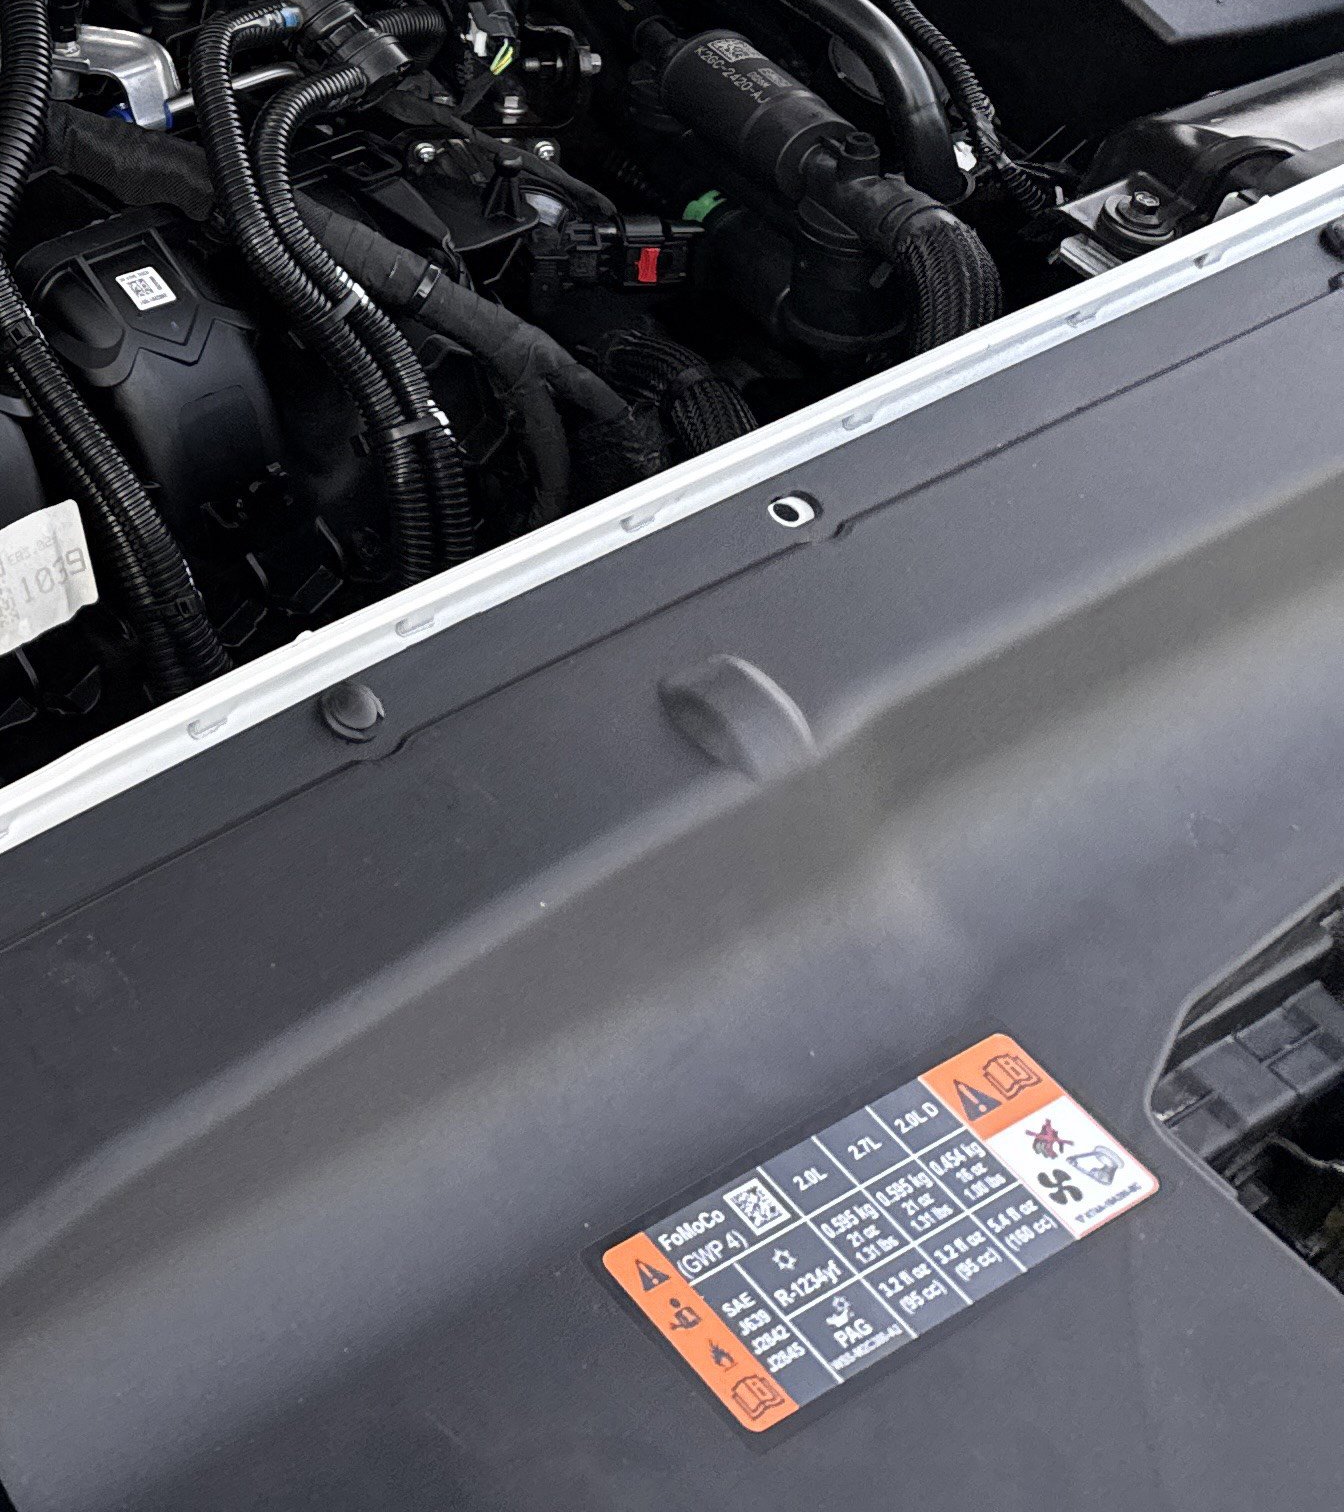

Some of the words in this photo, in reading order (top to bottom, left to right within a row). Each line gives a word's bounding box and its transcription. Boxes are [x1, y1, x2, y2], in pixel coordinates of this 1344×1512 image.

[893, 1108, 928, 1132] 2.0L
[921, 1101, 940, 1117] D
[847, 1134, 881, 1158] 2.7L
[961, 1139, 986, 1159] kg
[791, 1165, 827, 1190] 2.0L
[908, 1170, 933, 1190] kg
[854, 1201, 879, 1222] kg
[657, 1206, 726, 1251] FoMoCo
[676, 1240, 729, 1276] (GWP
[721, 1229, 749, 1252] 4)
[772, 1260, 846, 1310] R-1234yf
[720, 1292, 756, 1317] SAE
[833, 1318, 873, 1347] PAG
